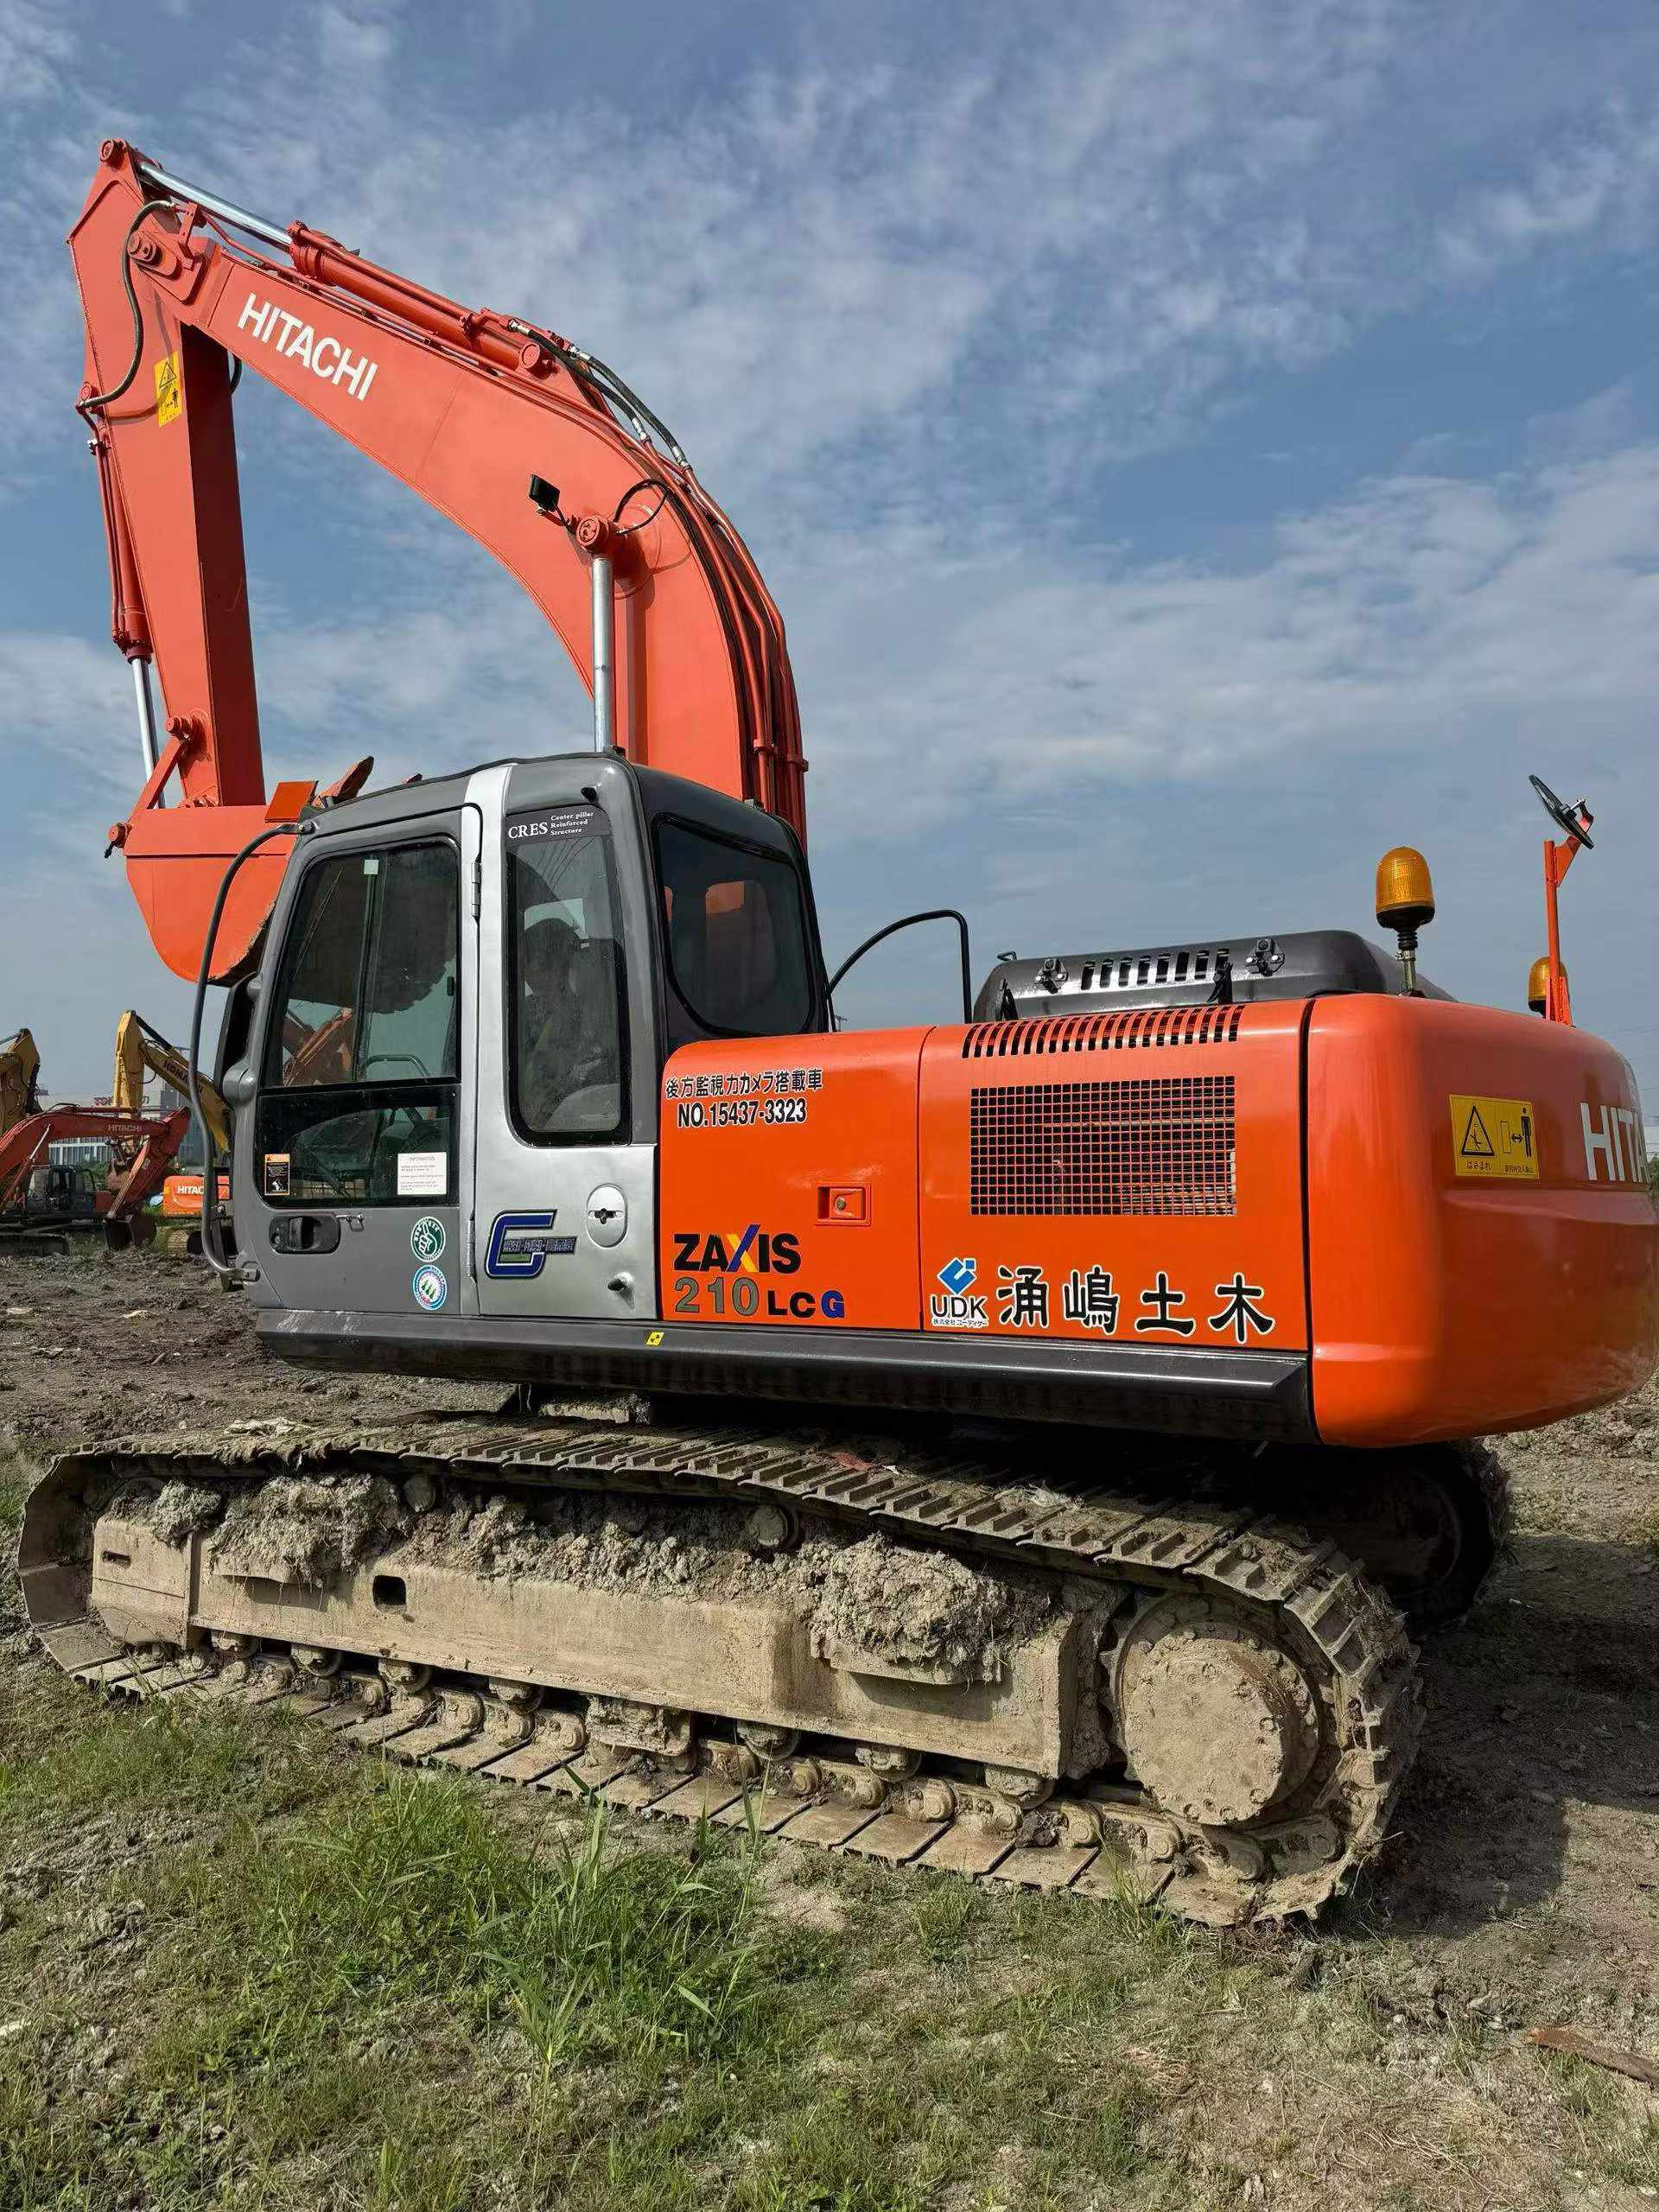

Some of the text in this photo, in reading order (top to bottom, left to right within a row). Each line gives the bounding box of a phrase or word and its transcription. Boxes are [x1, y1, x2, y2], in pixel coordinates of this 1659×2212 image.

[237, 292, 378, 402] HITACHI
[508, 822, 549, 839] CRES
[550, 819, 588, 829] Reinforced
[678, 1098, 807, 1128] NO.15437-3323
[673, 1224, 802, 1274] ZAXIS
[931, 1295, 987, 1319] UDK
